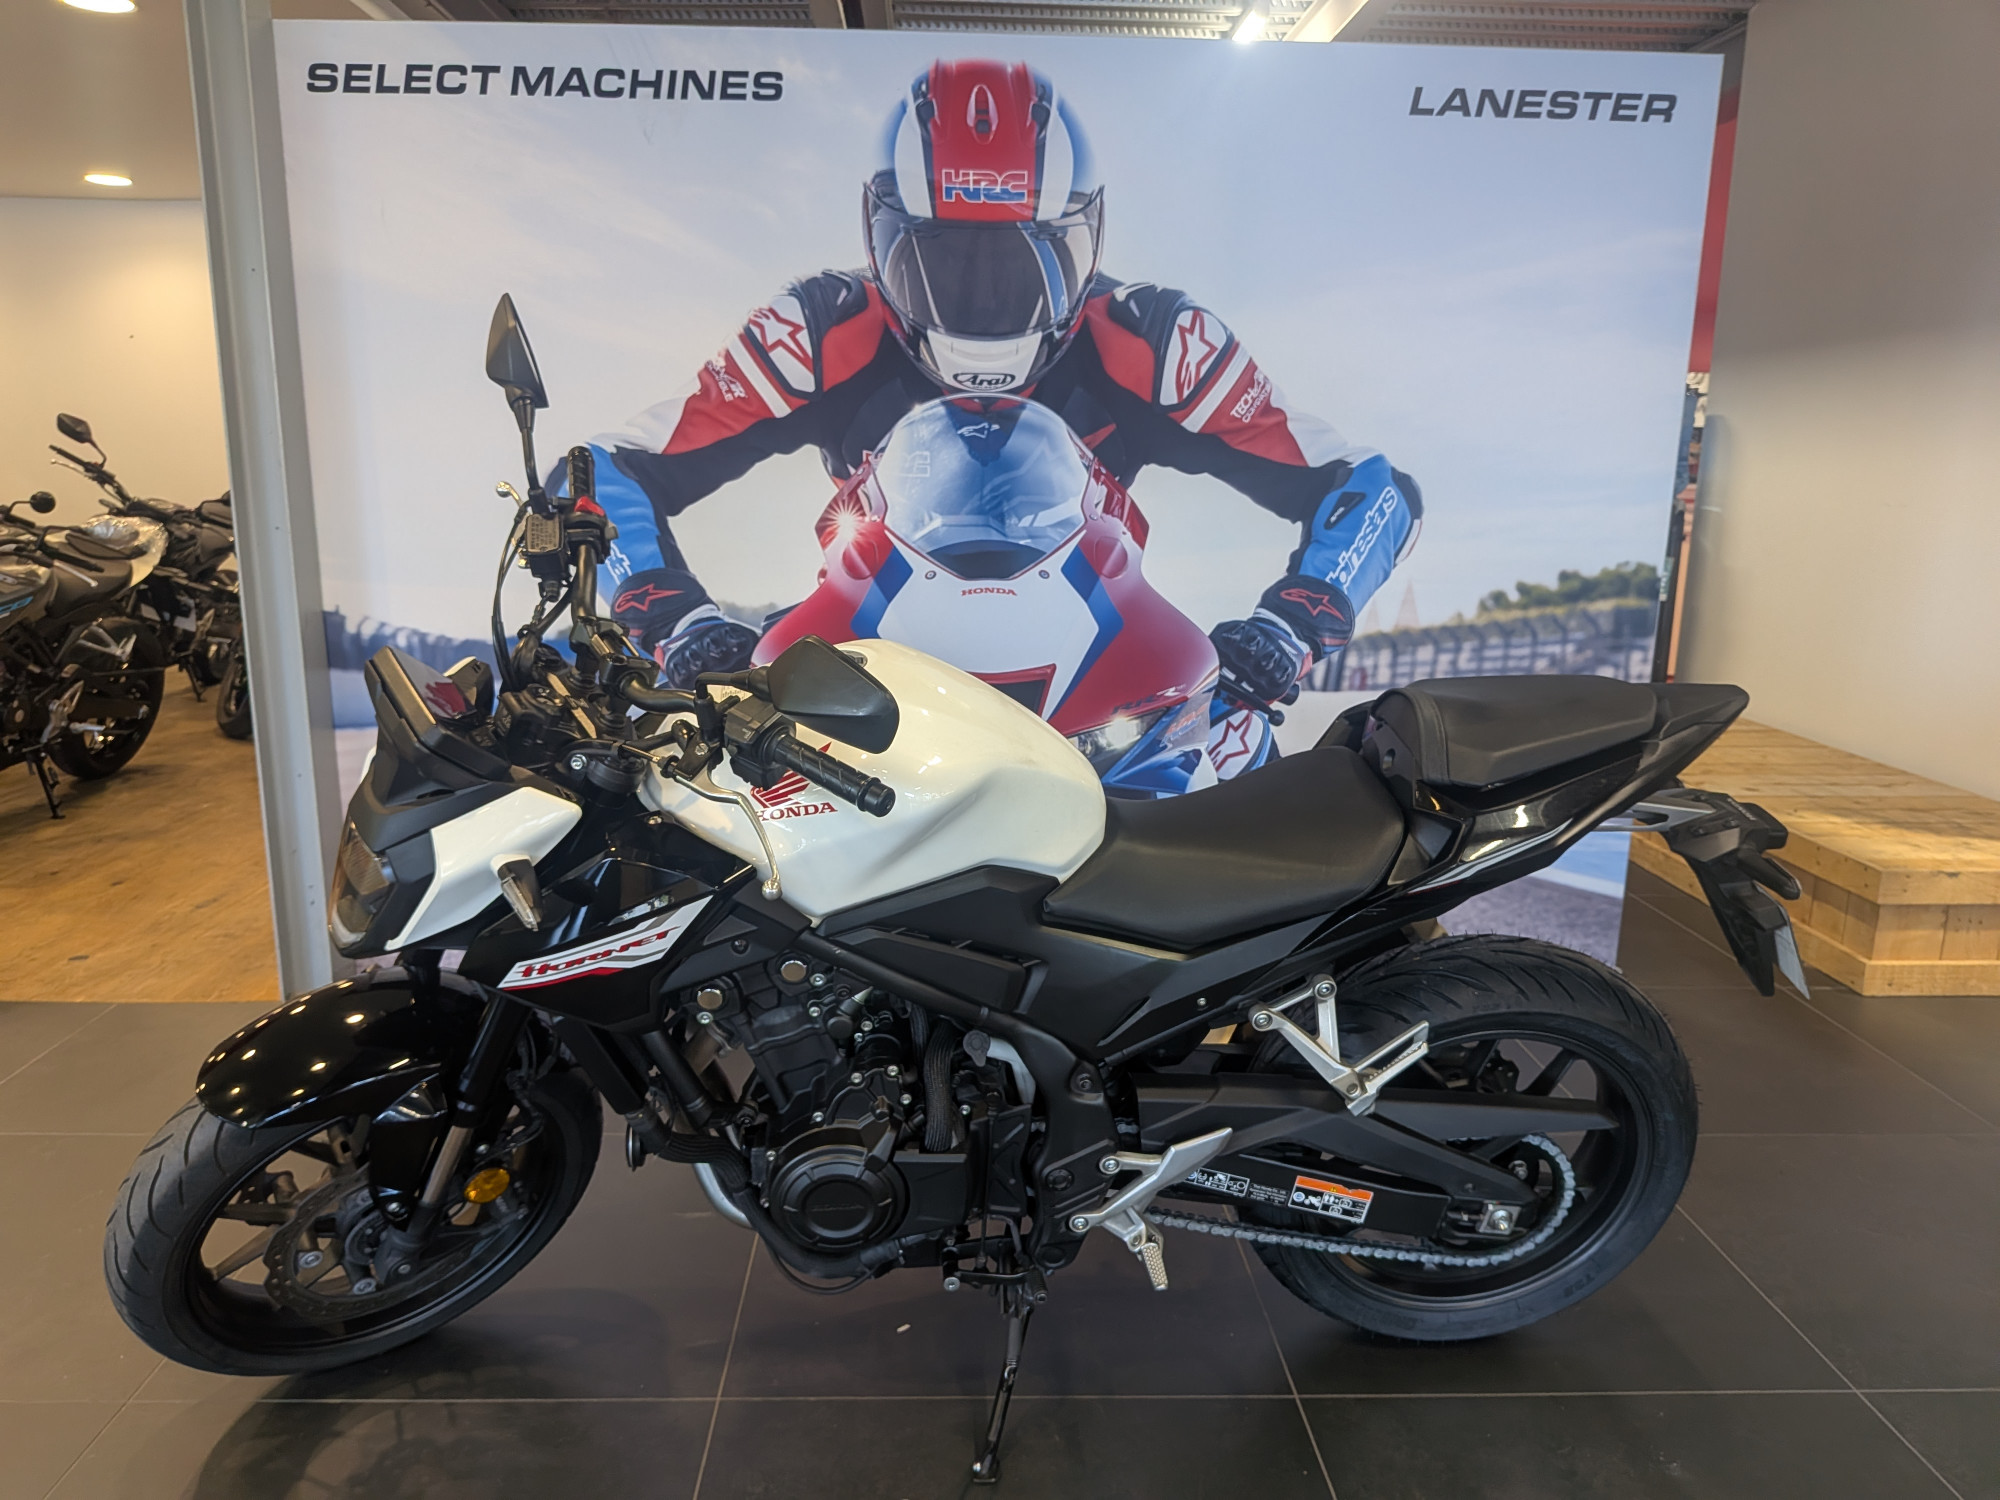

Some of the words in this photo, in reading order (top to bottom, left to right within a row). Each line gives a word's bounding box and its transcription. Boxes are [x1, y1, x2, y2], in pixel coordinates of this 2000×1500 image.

[306, 62, 501, 96] SELECT
[510, 66, 784, 102] MACHINES
[1408, 86, 1678, 124] LANESTER
[942, 169, 1028, 204] HRC
[961, 587, 1018, 597] HONDA
[755, 801, 839, 822] HONDA
